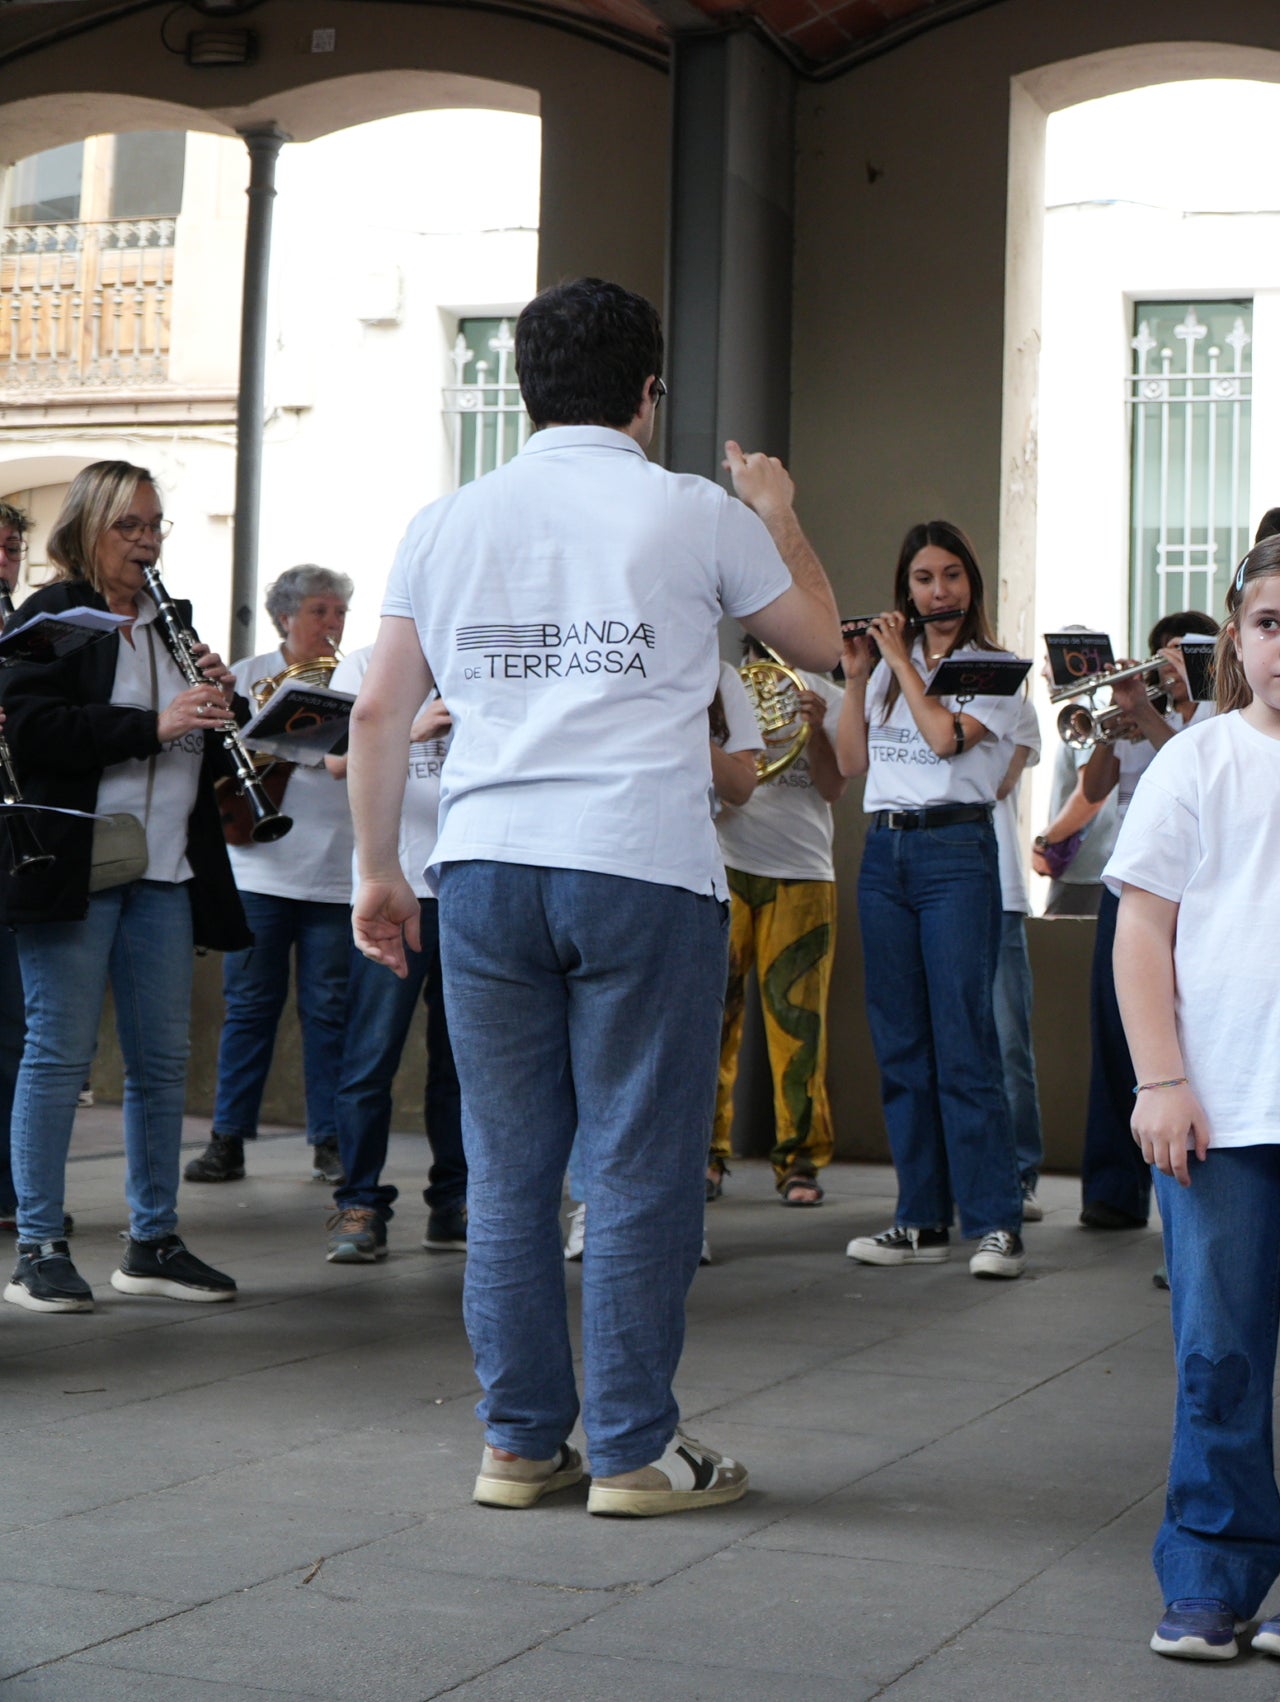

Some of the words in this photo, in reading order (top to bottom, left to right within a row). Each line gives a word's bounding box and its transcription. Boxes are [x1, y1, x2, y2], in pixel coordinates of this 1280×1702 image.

[542, 621, 651, 648] BANDA
[464, 667, 482, 680] DE
[484, 651, 647, 679] TERRASSA
